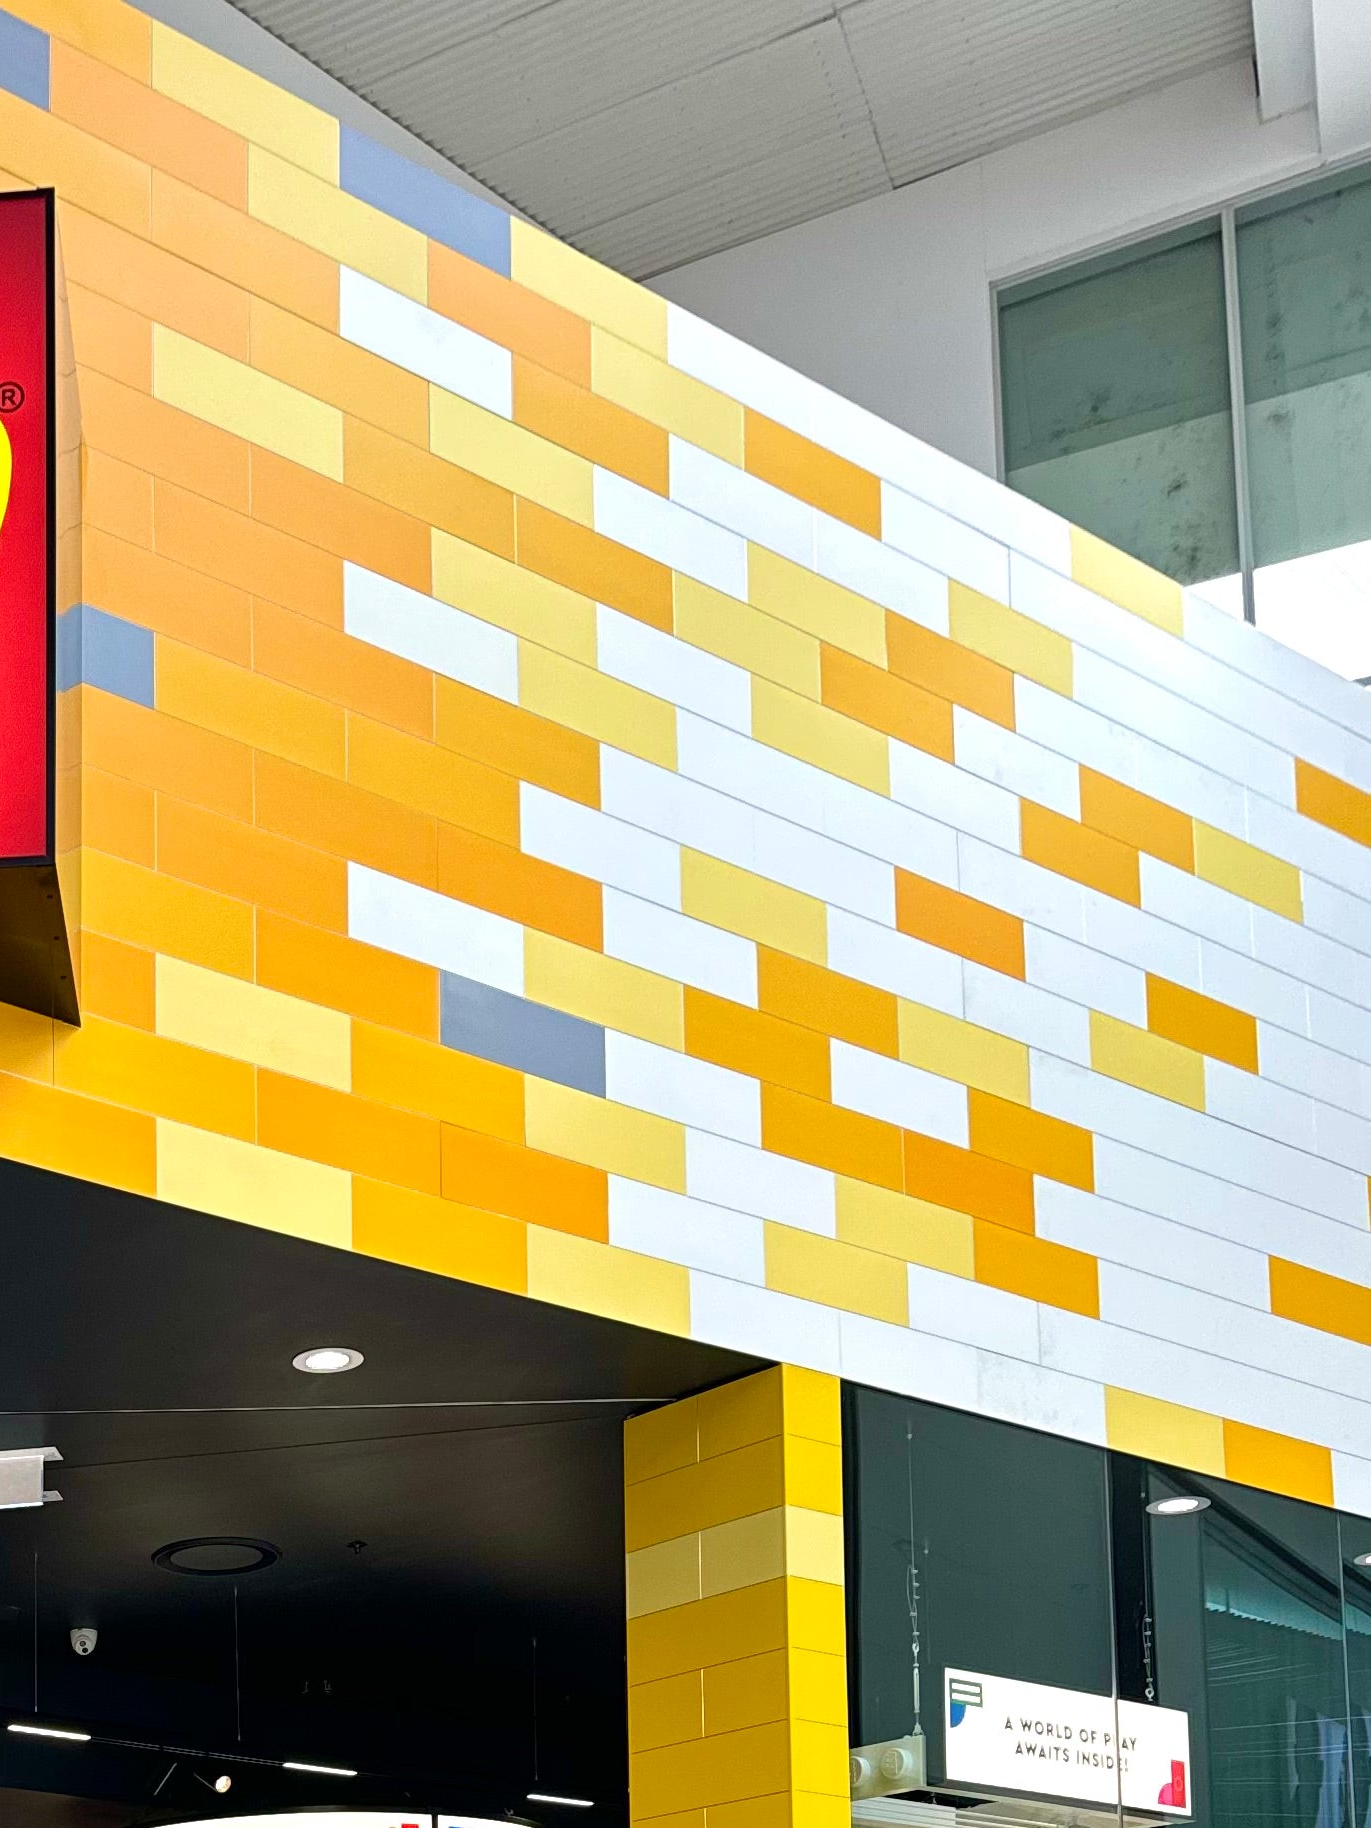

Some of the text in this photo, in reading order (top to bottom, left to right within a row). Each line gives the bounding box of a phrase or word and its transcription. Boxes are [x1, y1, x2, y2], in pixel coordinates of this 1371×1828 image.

[1005, 1716, 1013, 1730] A
[1020, 1718, 1072, 1740] WORLD
[1080, 1729, 1097, 1744] OF
[1015, 1741, 1070, 1763] AWAITS
